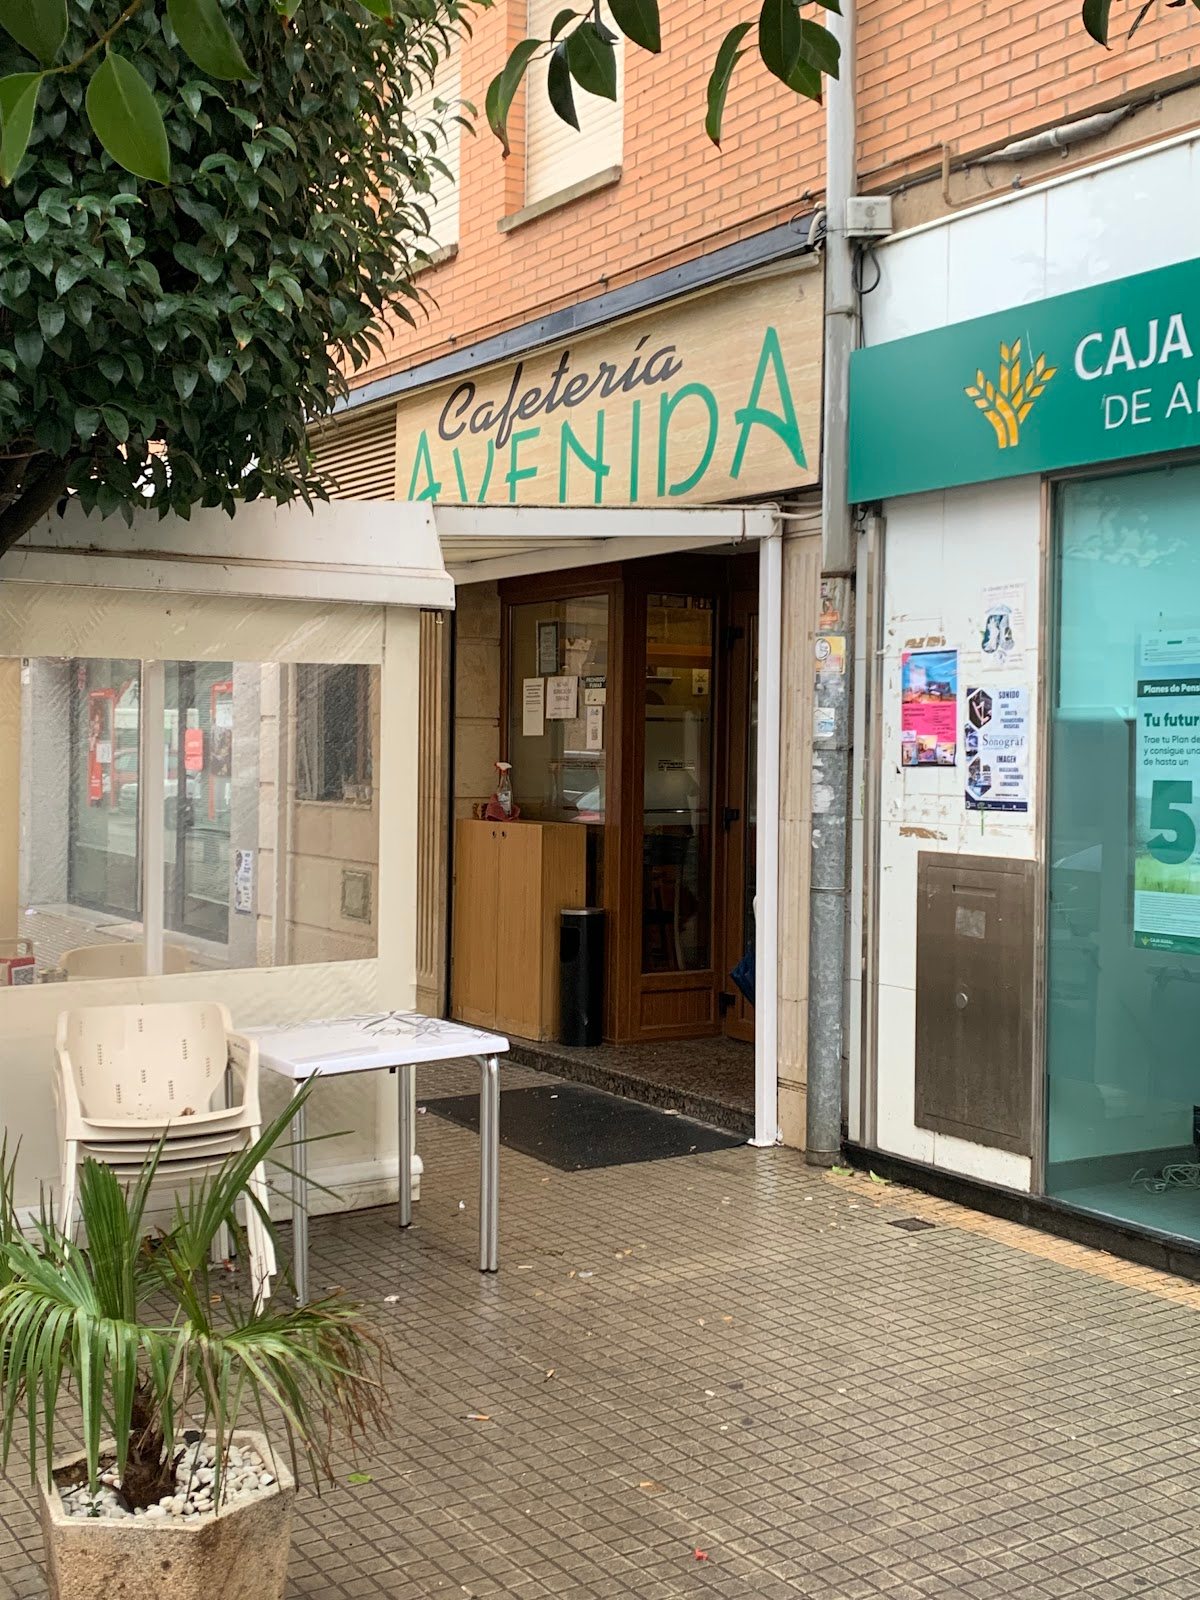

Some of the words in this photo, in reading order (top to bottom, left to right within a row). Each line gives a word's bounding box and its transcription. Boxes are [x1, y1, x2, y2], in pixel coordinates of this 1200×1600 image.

[1074, 313, 1194, 381] CAJA
[438, 334, 683, 449] Cafetería
[1104, 388, 1153, 430] DE
[1165, 379, 1200, 419] A
[408, 326, 808, 504] AVENIDA
[998, 690, 1020, 699] SONIDO
[1143, 684, 1169, 694] Planes
[1170, 683, 1180, 693] de
[1181, 683, 1200, 692] Pens
[1143, 712, 1160, 727] Tu
[982, 733, 1025, 748] Sonograf
[1143, 735, 1160, 743] Trae
[1171, 735, 1189, 743] Plan
[1149, 746, 1184, 756] consigue
[996, 755, 1016, 763] IMAGEN
[1143, 757, 1153, 765] de
[1155, 757, 1177, 765] hasta
[1146, 779, 1197, 866] 5
